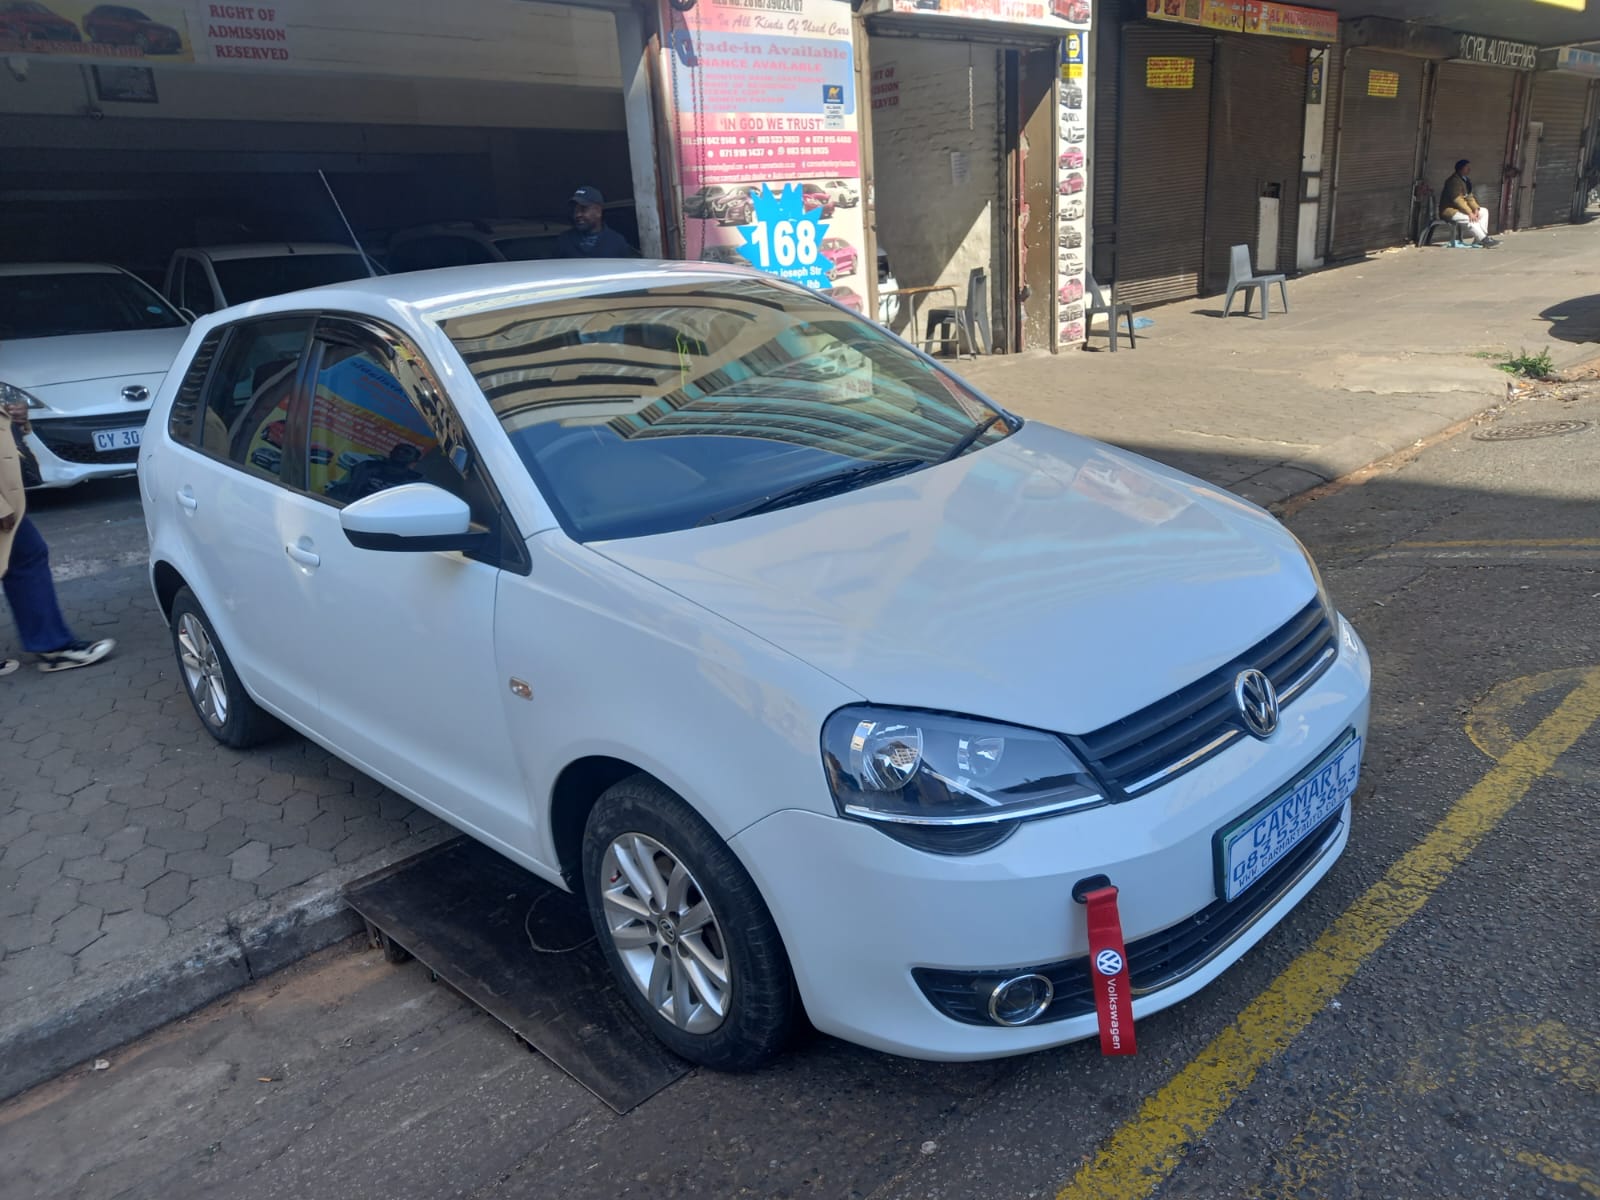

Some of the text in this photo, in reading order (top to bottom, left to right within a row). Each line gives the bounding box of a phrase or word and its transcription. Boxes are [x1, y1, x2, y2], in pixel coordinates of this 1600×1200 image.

[208, 4, 276, 21] RIGHT OF
[207, 24, 286, 41] ADMISSION
[732, 14, 751, 29] All
[754, 15, 784, 30] Kinds
[787, 19, 798, 34] Of
[801, 20, 826, 34] Used
[828, 23, 850, 36] Cars
[215, 45, 289, 61] RESERVED
[768, 43, 848, 60] Available
[752, 61, 823, 73] AVAILABLE
[740, 118, 763, 130] GOD
[767, 118, 784, 130] WE
[751, 219, 818, 267] 168
[97, 432, 114, 448] CY
[1253, 754, 1345, 848] CARMART
[1233, 764, 1357, 882] 083 533 3653
[1106, 978, 1121, 1050] Volkswagen
